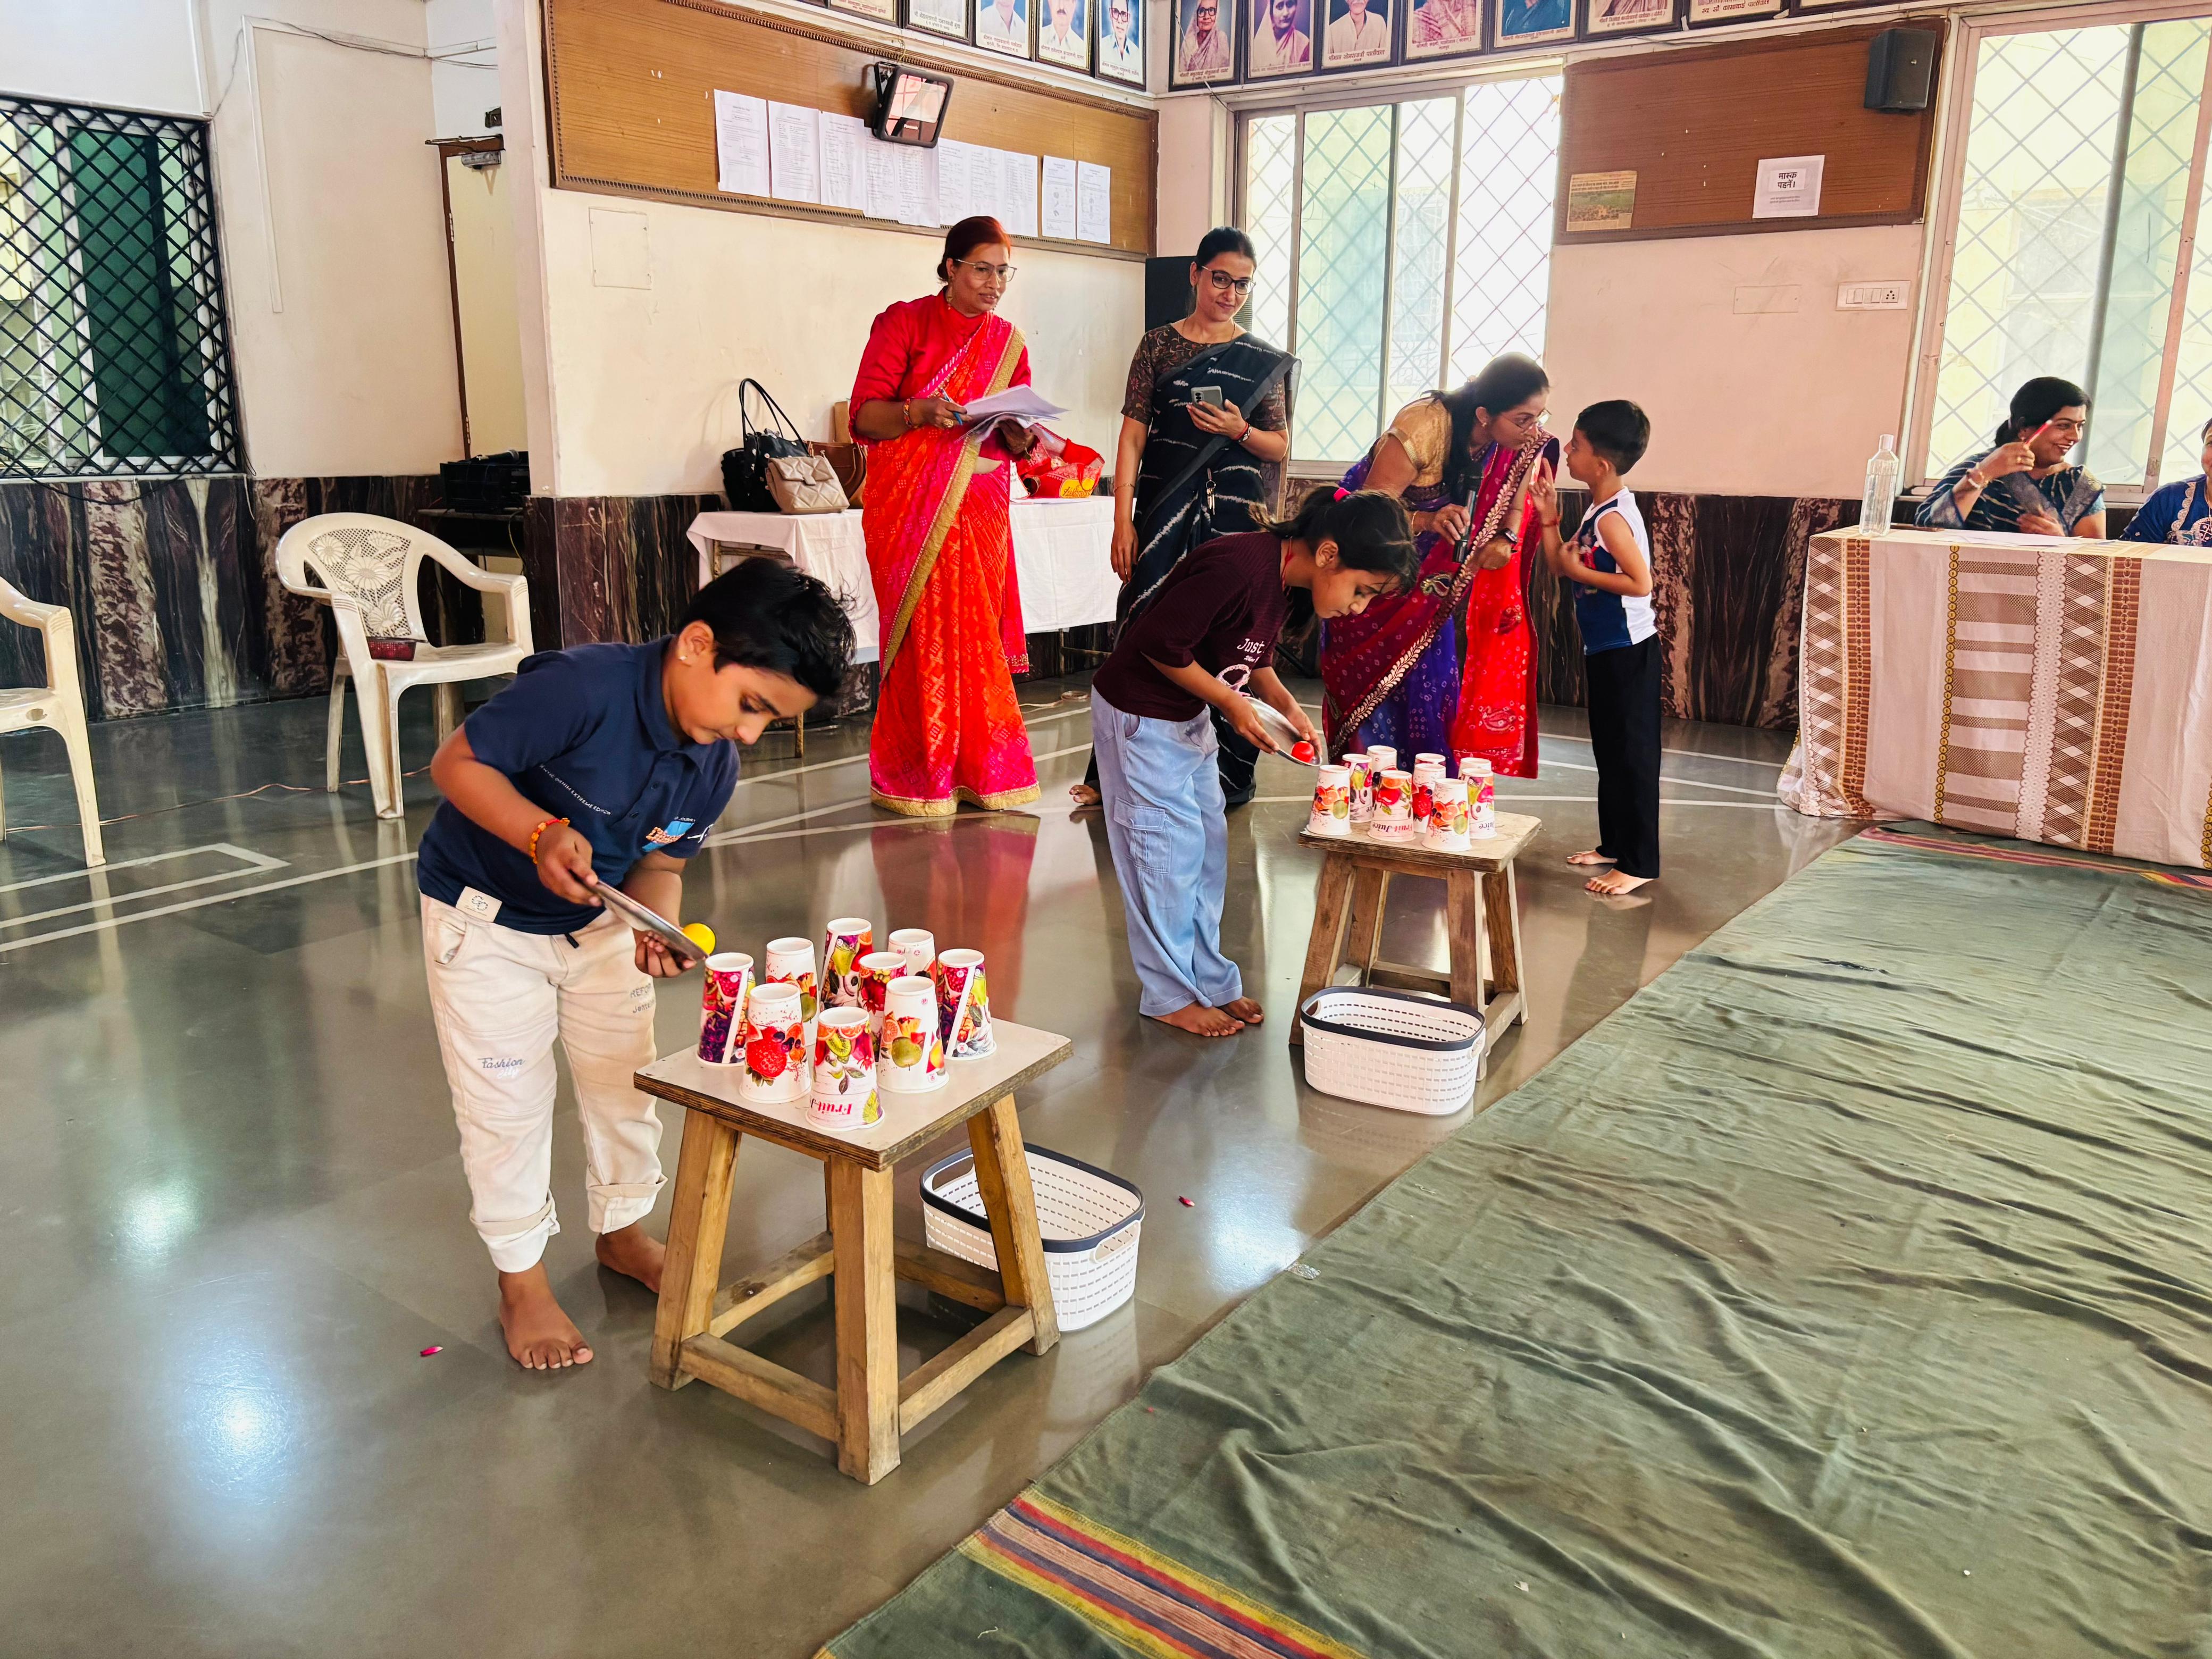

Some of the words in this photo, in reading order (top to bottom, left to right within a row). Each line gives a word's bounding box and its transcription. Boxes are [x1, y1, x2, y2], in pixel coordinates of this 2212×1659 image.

[1236, 638, 1265, 654] Just
[477, 1057, 525, 1068] Fashion
[818, 1101, 852, 1115] Fruit
